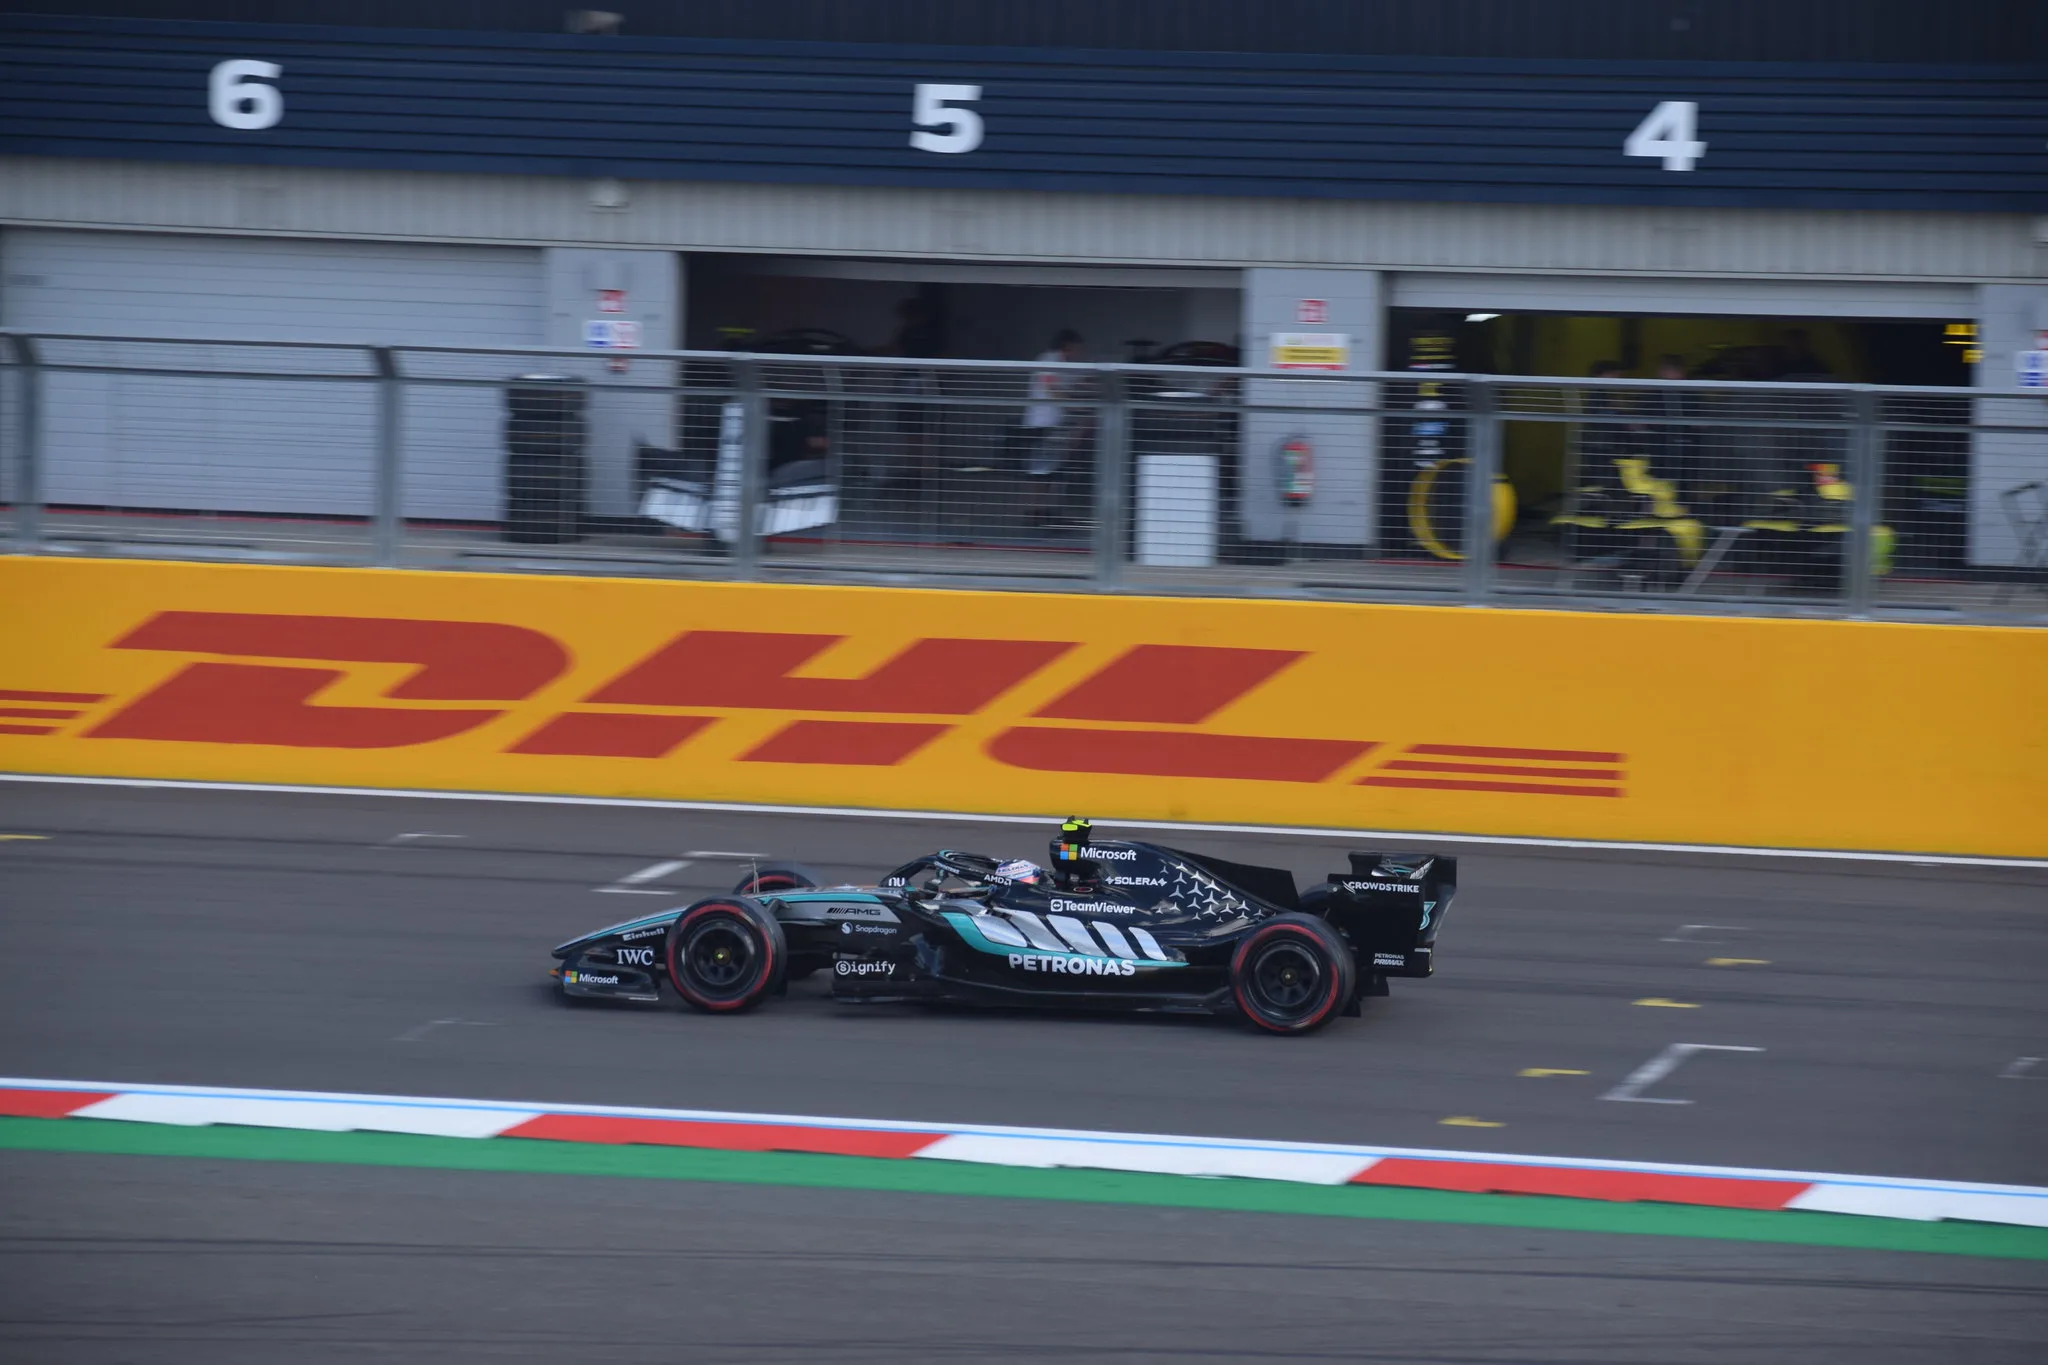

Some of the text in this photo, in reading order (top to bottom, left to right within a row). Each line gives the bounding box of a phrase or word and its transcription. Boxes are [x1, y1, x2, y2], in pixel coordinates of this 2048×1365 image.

[208, 58, 284, 131] 6
[909, 82, 985, 155] 5
[1622, 101, 1708, 172] 4
[77, 610, 1383, 785] DHL
[1080, 846, 1137, 861] Microsoft
[984, 874, 1004, 885] AMD
[1114, 876, 1158, 887] SOLERA
[1348, 881, 1420, 893] CROWDSTRIKE
[845, 908, 882, 916] AMG
[1063, 900, 1136, 915] TeamViewer
[855, 924, 898, 936] Snapdragon
[616, 948, 654, 966] IWC
[1008, 953, 1136, 977] PETRONAS
[578, 973, 619, 985] Microsoft
